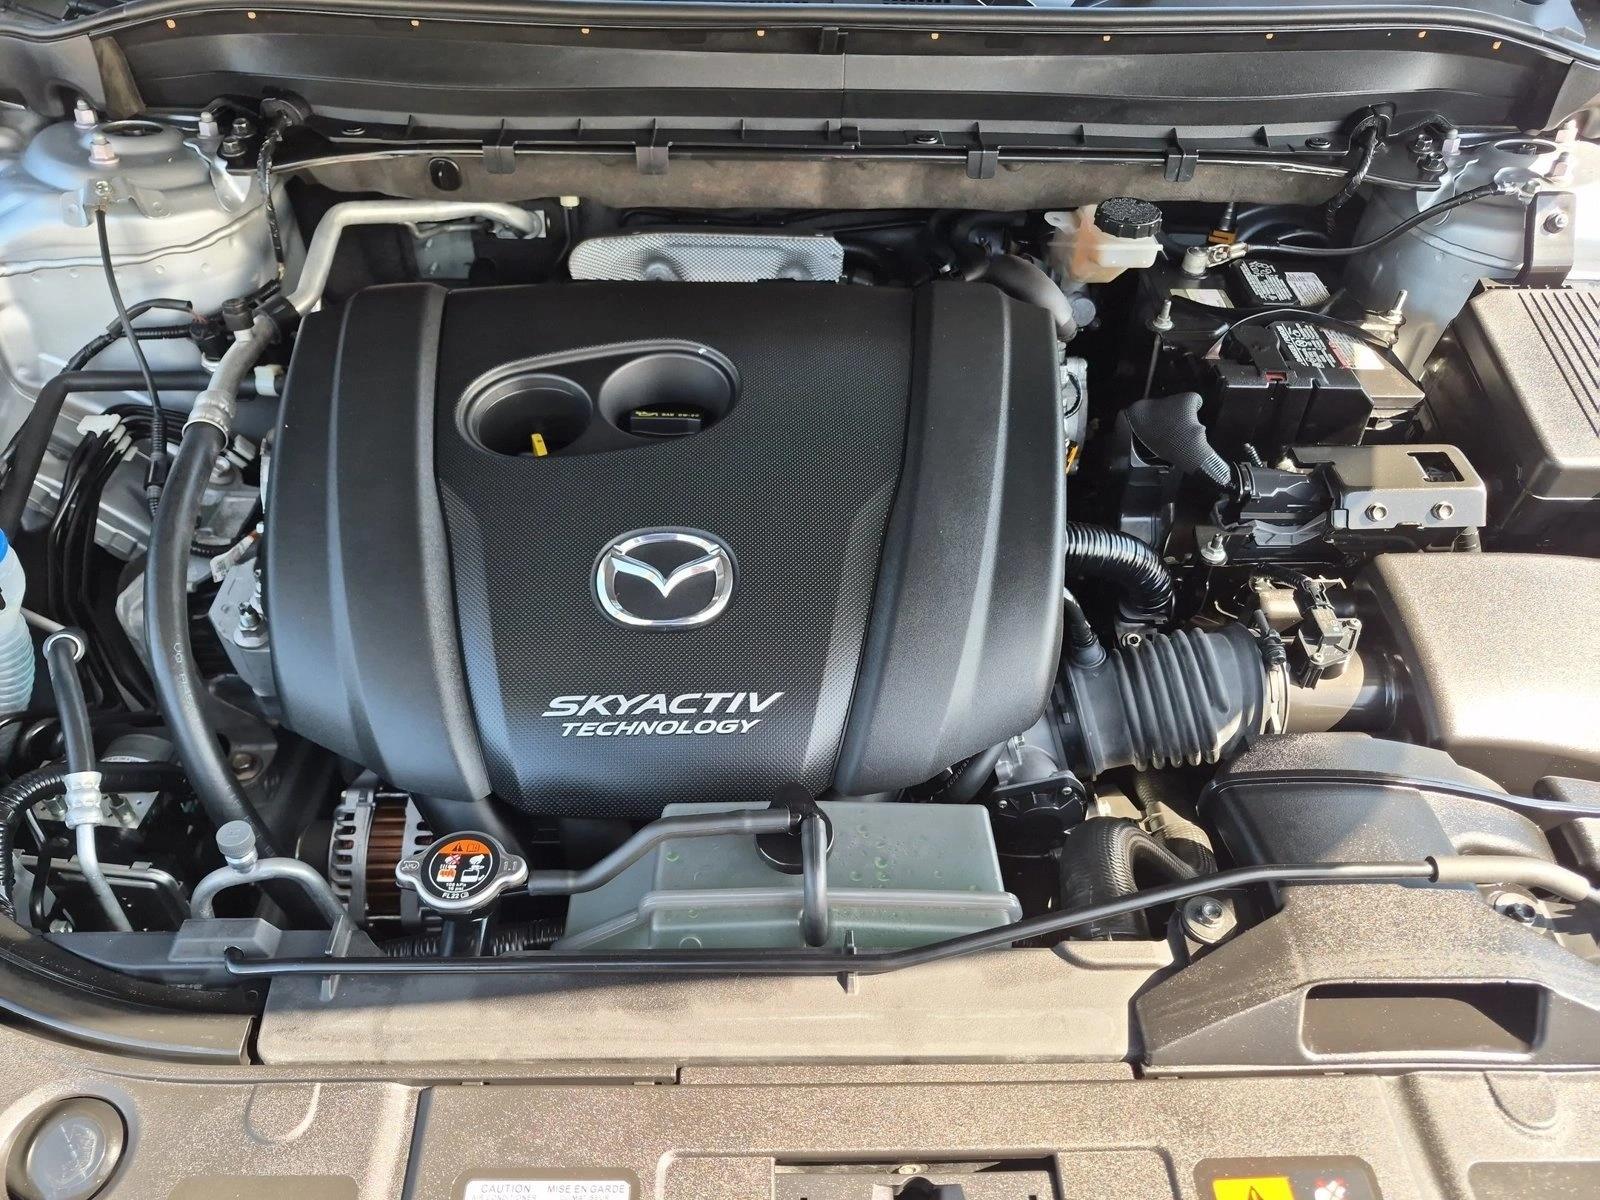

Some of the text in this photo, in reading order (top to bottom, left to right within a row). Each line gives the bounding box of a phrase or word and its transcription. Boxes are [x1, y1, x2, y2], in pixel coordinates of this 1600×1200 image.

[541, 692, 785, 717] SKYACTIV
[561, 719, 762, 737] TECHNOLOGY
[481, 1184, 531, 1194] CAUTION
[547, 1184, 625, 1194] MISE EN GARDE
